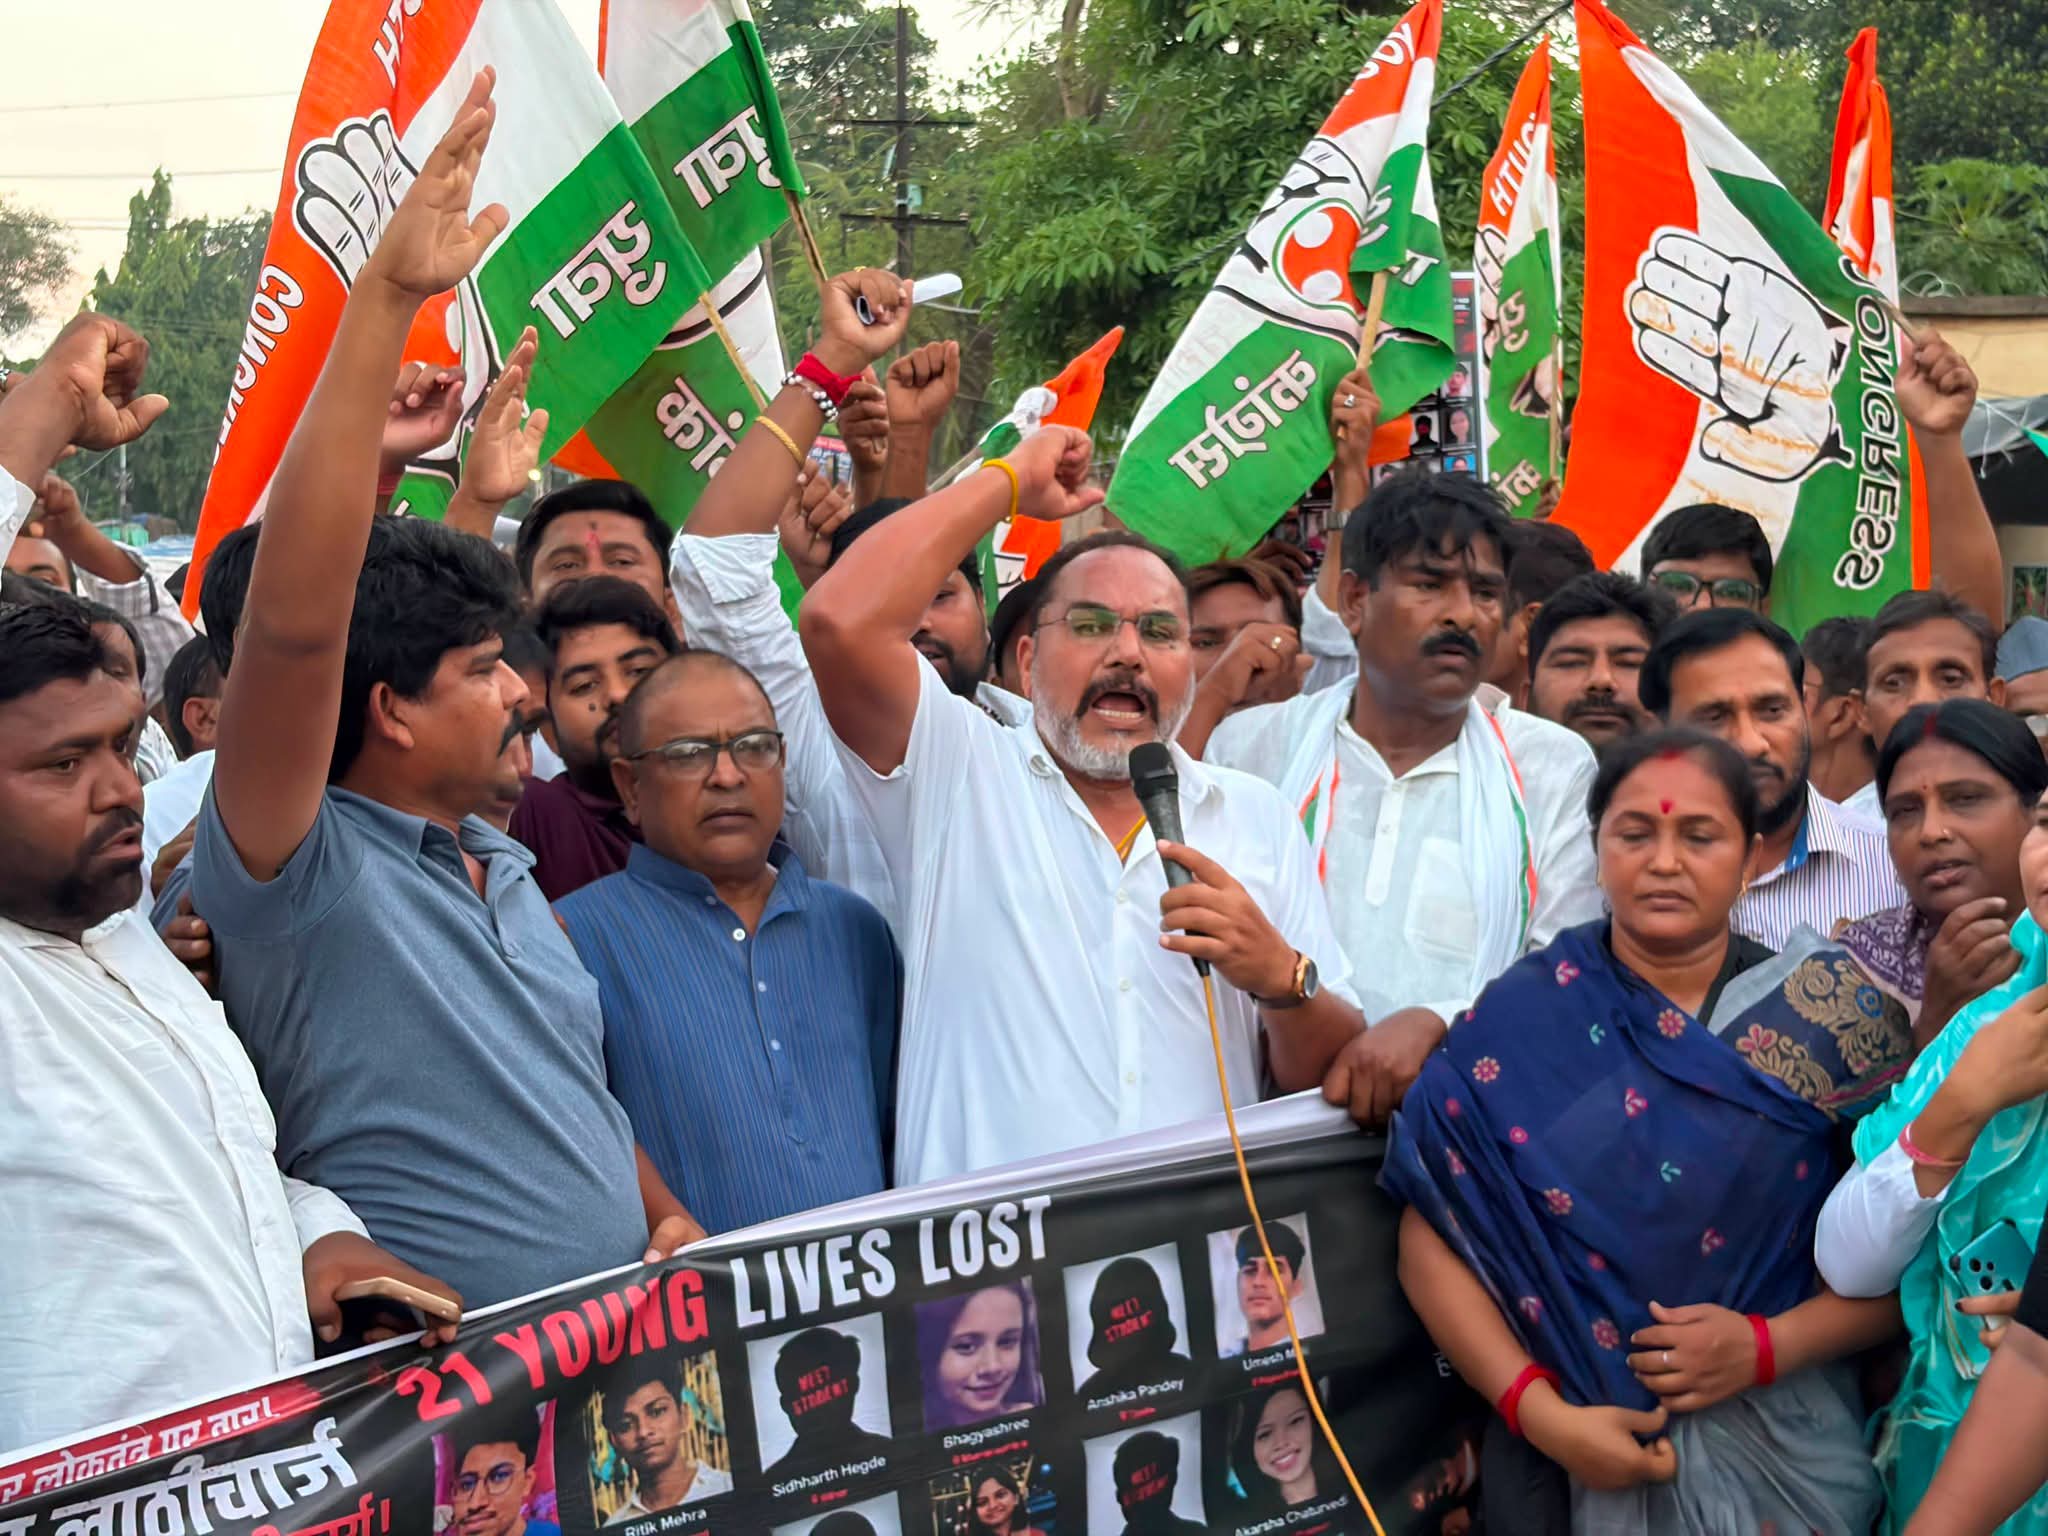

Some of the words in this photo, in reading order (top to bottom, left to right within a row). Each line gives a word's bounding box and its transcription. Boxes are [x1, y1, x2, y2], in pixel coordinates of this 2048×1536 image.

[394, 1351, 493, 1422] 21
[492, 1271, 709, 1389] YOUNG
[730, 1227, 896, 1330] LIVES
[917, 1194, 1053, 1286] LOST
[1138, 1378, 1185, 1397] Pandey
[943, 1418, 1030, 1449] Bhagyashree
[772, 1467, 839, 1497] Sidhharth
[840, 1455, 887, 1478] Hegde
[660, 1508, 707, 1532] Mehra
